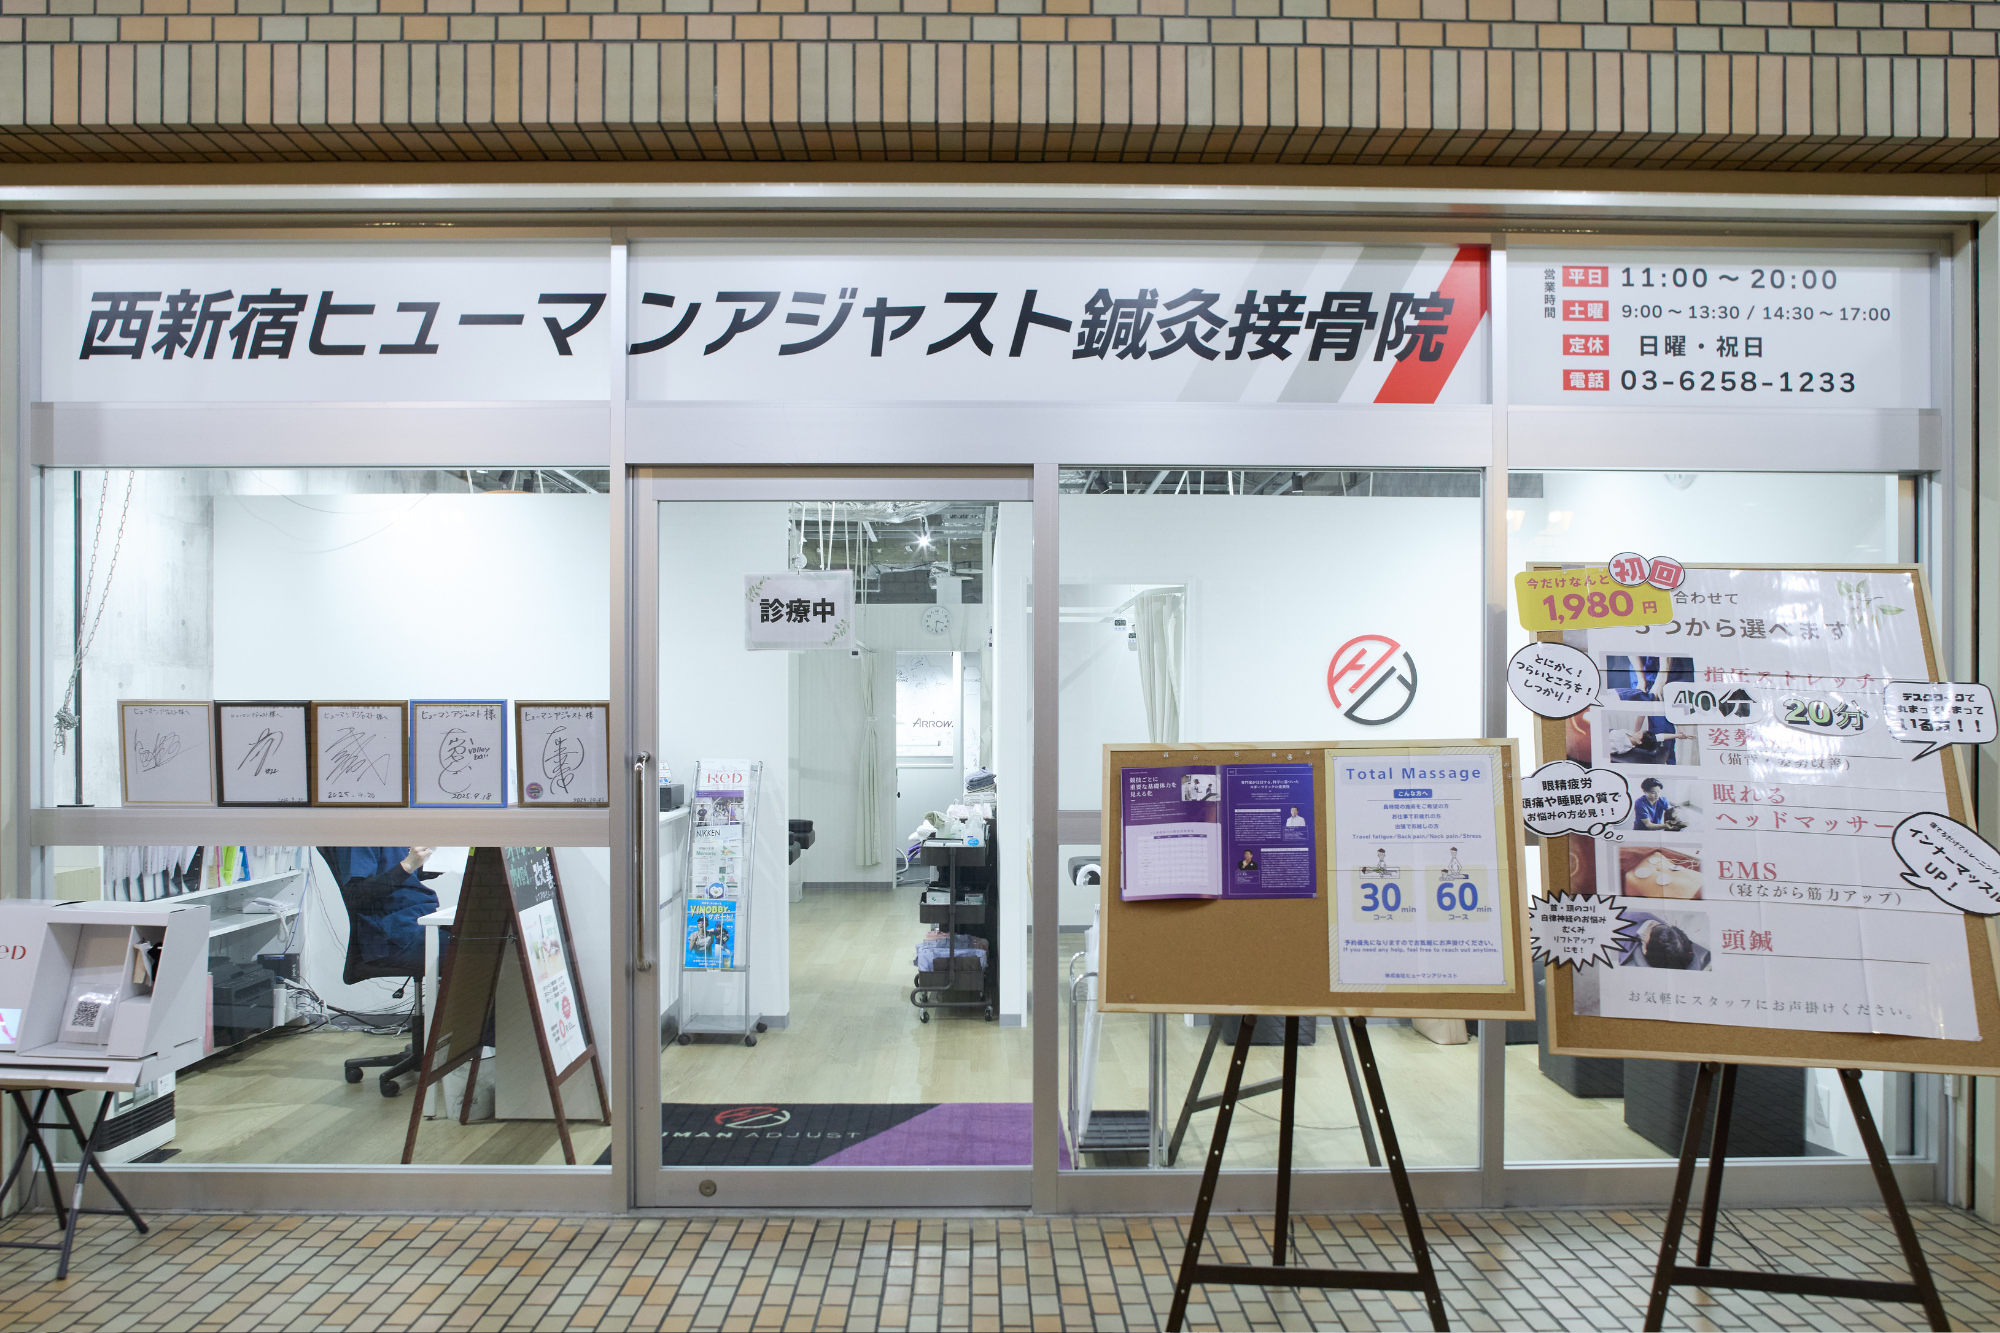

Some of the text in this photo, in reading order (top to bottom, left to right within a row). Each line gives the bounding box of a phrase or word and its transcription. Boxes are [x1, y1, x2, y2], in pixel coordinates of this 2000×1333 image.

[1569, 268, 1604, 285] 平日
[1544, 268, 1556, 320] 営業時間
[1569, 303, 1604, 319] 土曜
[79, 288, 1454, 362] 西新宿ヒューマンアジャスト鍼灸接骨院
[1569, 335, 1764, 358] 定休 日曜・祝日
[1569, 370, 1856, 393] 電話 03-6258-1233
[1527, 575, 1609, 590] 今だけなんと
[760, 597, 835, 623] 診療中
[1535, 654, 1583, 678] とにかく！
[1516, 661, 1592, 696] つらいところを！
[1672, 688, 1758, 718] 40分
[1902, 693, 1976, 703] デスクワークで
[1782, 698, 1870, 730] 20分
[1346, 767, 1481, 781] Total Massage
[1542, 777, 1593, 791] 眼精疲労
[1522, 792, 1622, 808] 頭痛や睡眠の質で
[1713, 784, 1785, 805] 眠れる
[1718, 860, 1778, 881] EMS
[1541, 914, 1607, 924] 自律神経のお悩み
[1550, 904, 1596, 913] 首・頭のコリ
[1553, 936, 1595, 944] リフトアップ
[1562, 925, 1585, 934] むくみ
[1721, 929, 1774, 953] 頭鍼
[1629, 990, 1912, 1020] お気軽にスタッフにお声掛けください。
